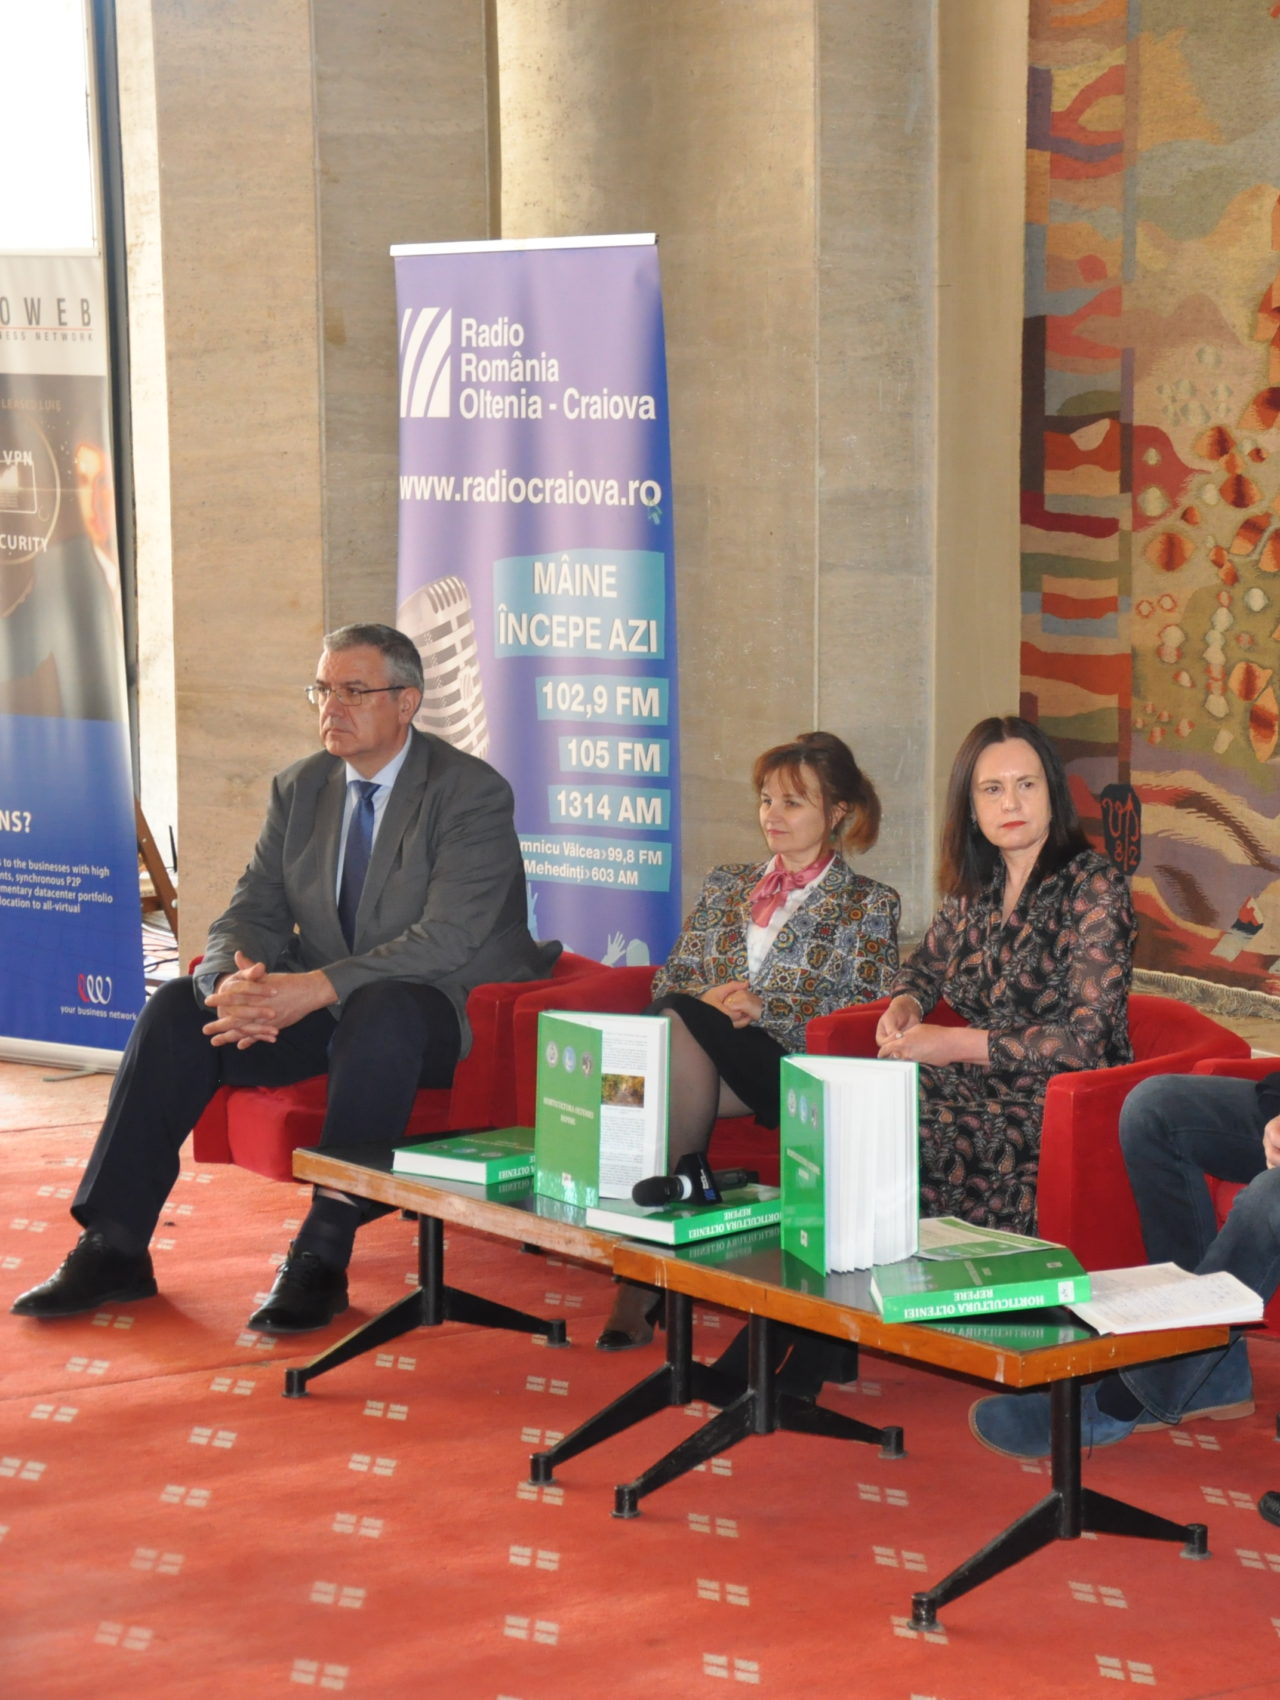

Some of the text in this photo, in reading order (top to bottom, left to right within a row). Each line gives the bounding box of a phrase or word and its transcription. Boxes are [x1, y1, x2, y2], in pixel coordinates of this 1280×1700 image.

[35, 332, 93, 342] NETWORK
[460, 316, 525, 348] Radio
[460, 351, 560, 383] România
[459, 388, 543, 420] Oltenia
[563, 387, 657, 421] Craiova
[3, 450, 33, 466] VPN
[399, 469, 662, 507] www.radiocraiova.ro
[0, 534, 48, 552] CURITY
[533, 554, 618, 598] MÂINE
[497, 603, 657, 653] ÎNCEPE AZI
[542, 681, 660, 718] 102,9 FM
[567, 738, 662, 773] 105 FM
[557, 790, 663, 825] 1314 AM
[0, 809, 32, 833] NS?
[607, 847, 635, 865] 99,8
[639, 850, 663, 865] FM
[4, 858, 110, 879] to the businesses with high
[591, 867, 614, 883] 603
[617, 870, 639, 885] AM
[15, 873, 65, 886] synchronous
[66, 876, 82, 887] P2P
[34, 886, 76, 899] datacenter
[78, 891, 113, 904] portfolio
[32, 899, 41, 910] to
[42, 900, 81, 913] all-virtual
[60, 1006, 137, 1021] your business network
[726, 1212, 781, 1231] ORTICULTURA
[954, 1288, 994, 1302] REPERE
[904, 1295, 1045, 1319] HORTICULTURA OLTENIEI
